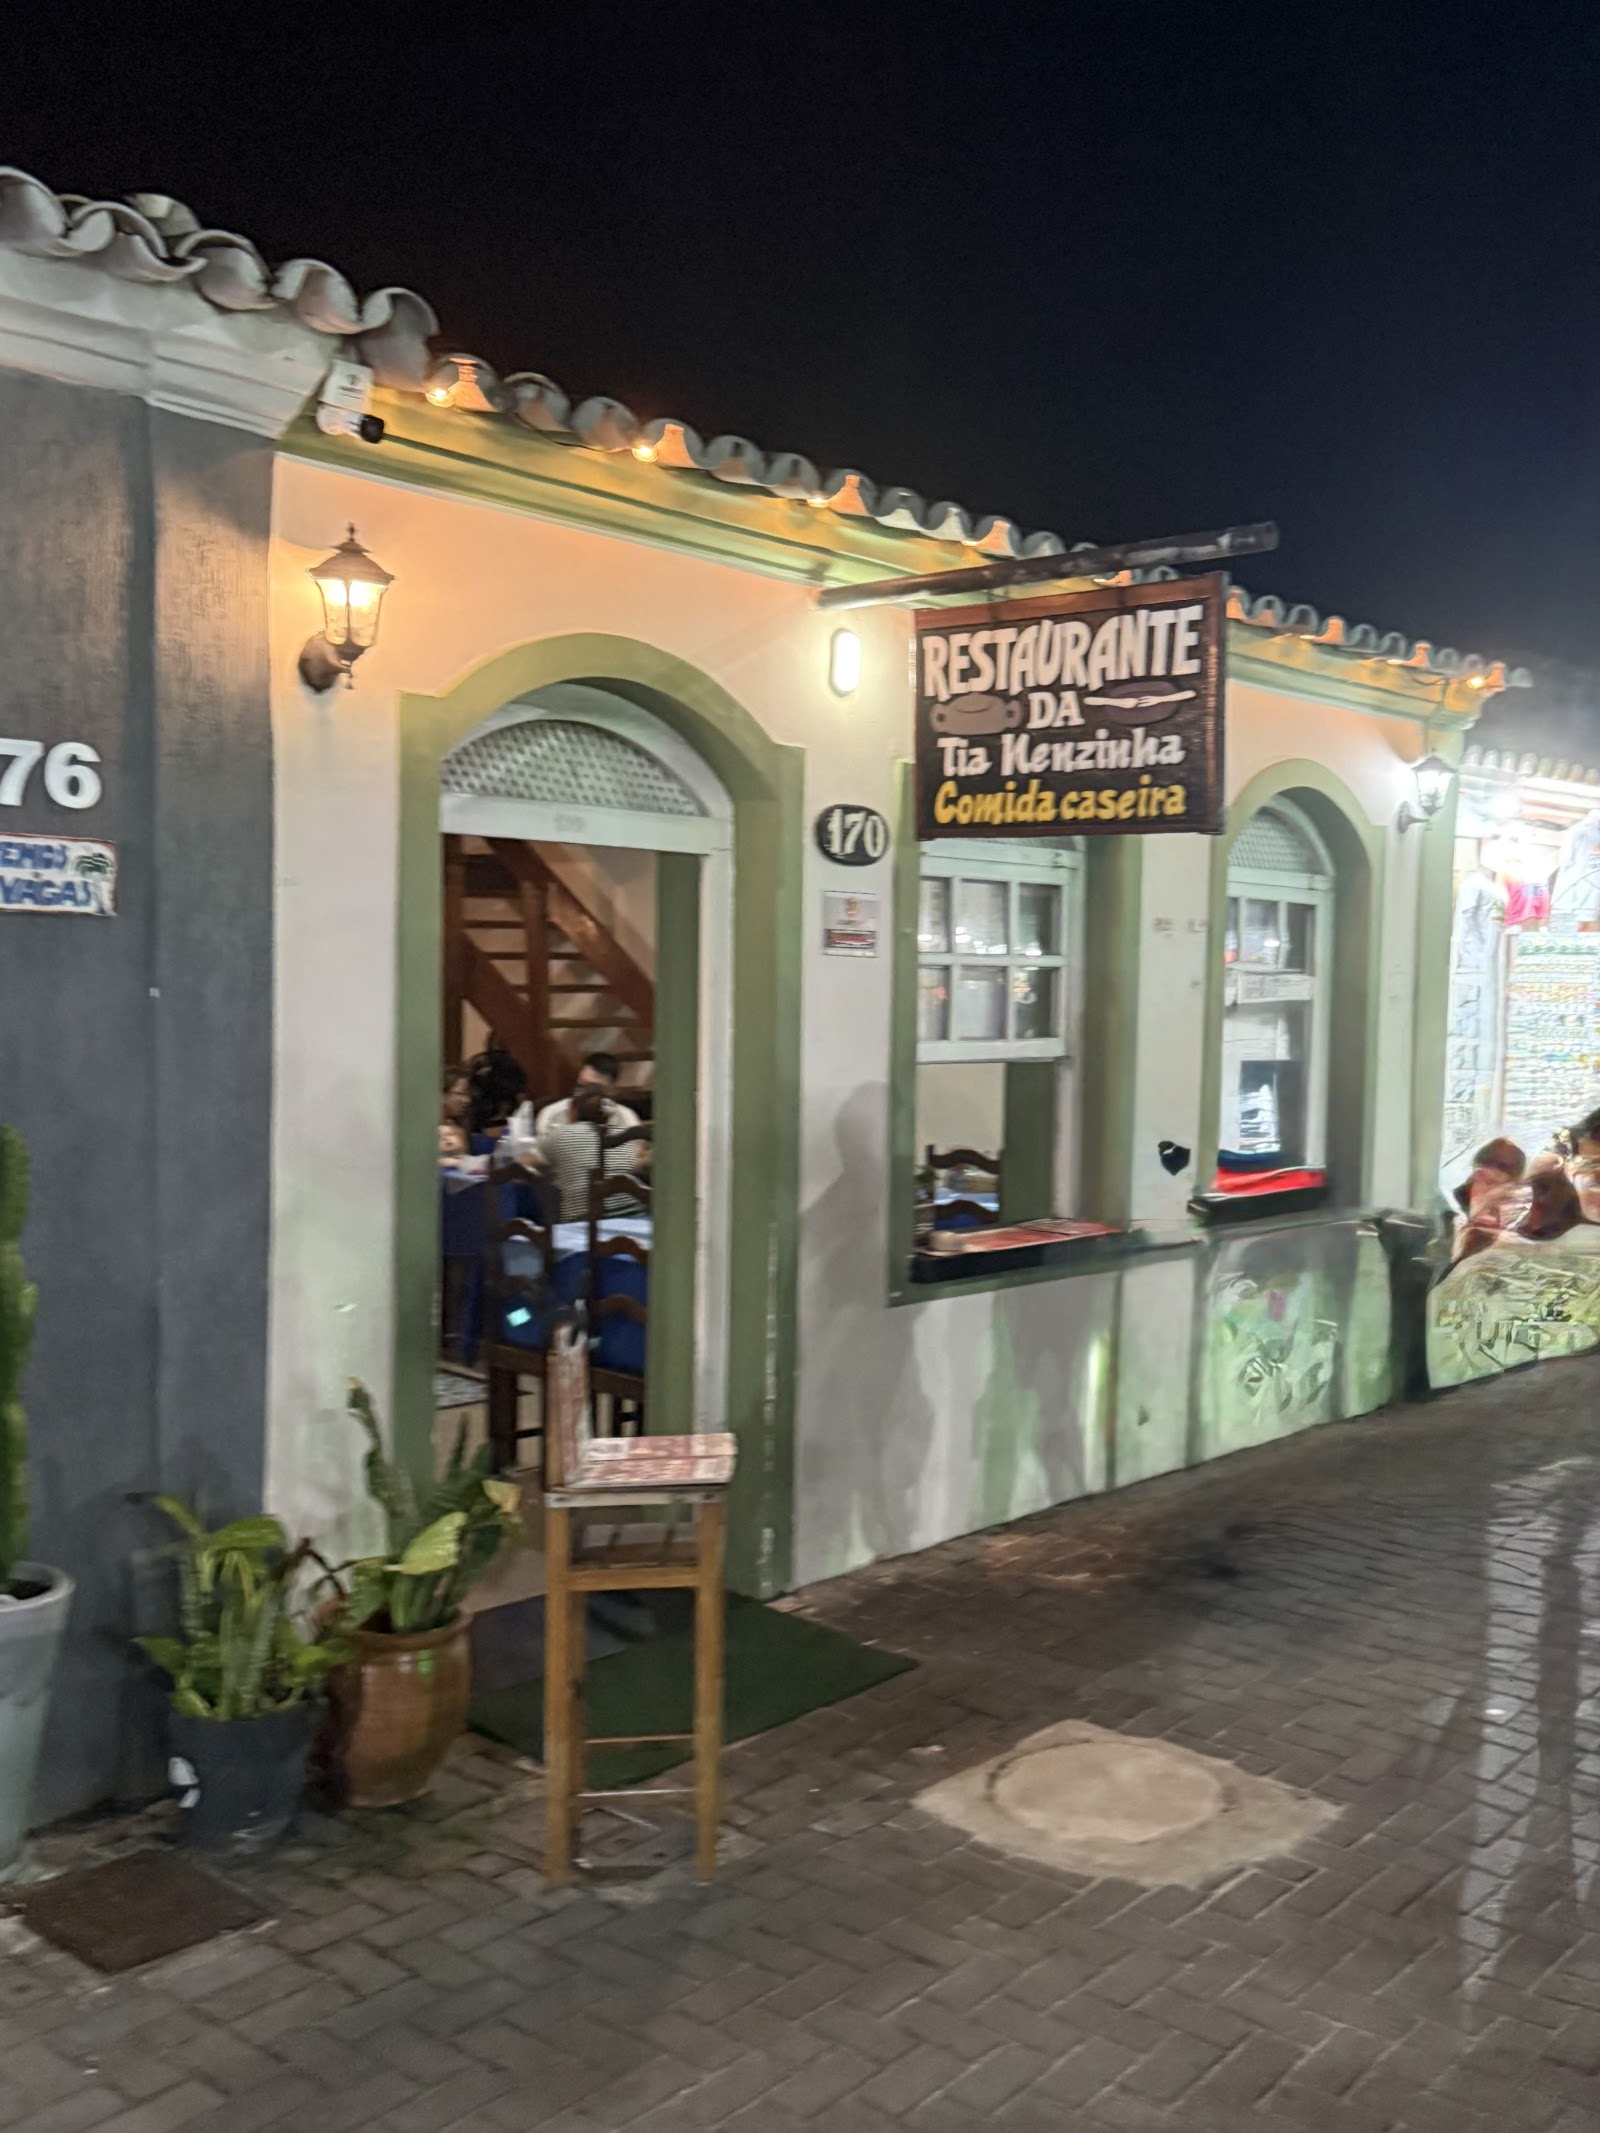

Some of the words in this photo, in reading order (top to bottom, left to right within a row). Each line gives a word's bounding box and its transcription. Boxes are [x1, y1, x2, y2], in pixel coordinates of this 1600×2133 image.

[922, 604, 1203, 702] RESTAURANTE
[1026, 690, 1085, 729] DA
[0, 737, 102, 809] 76
[936, 736, 993, 777] Tia
[934, 779, 1056, 825] Comida
[1060, 774, 1187, 820] caseira
[827, 808, 886, 858] 170
